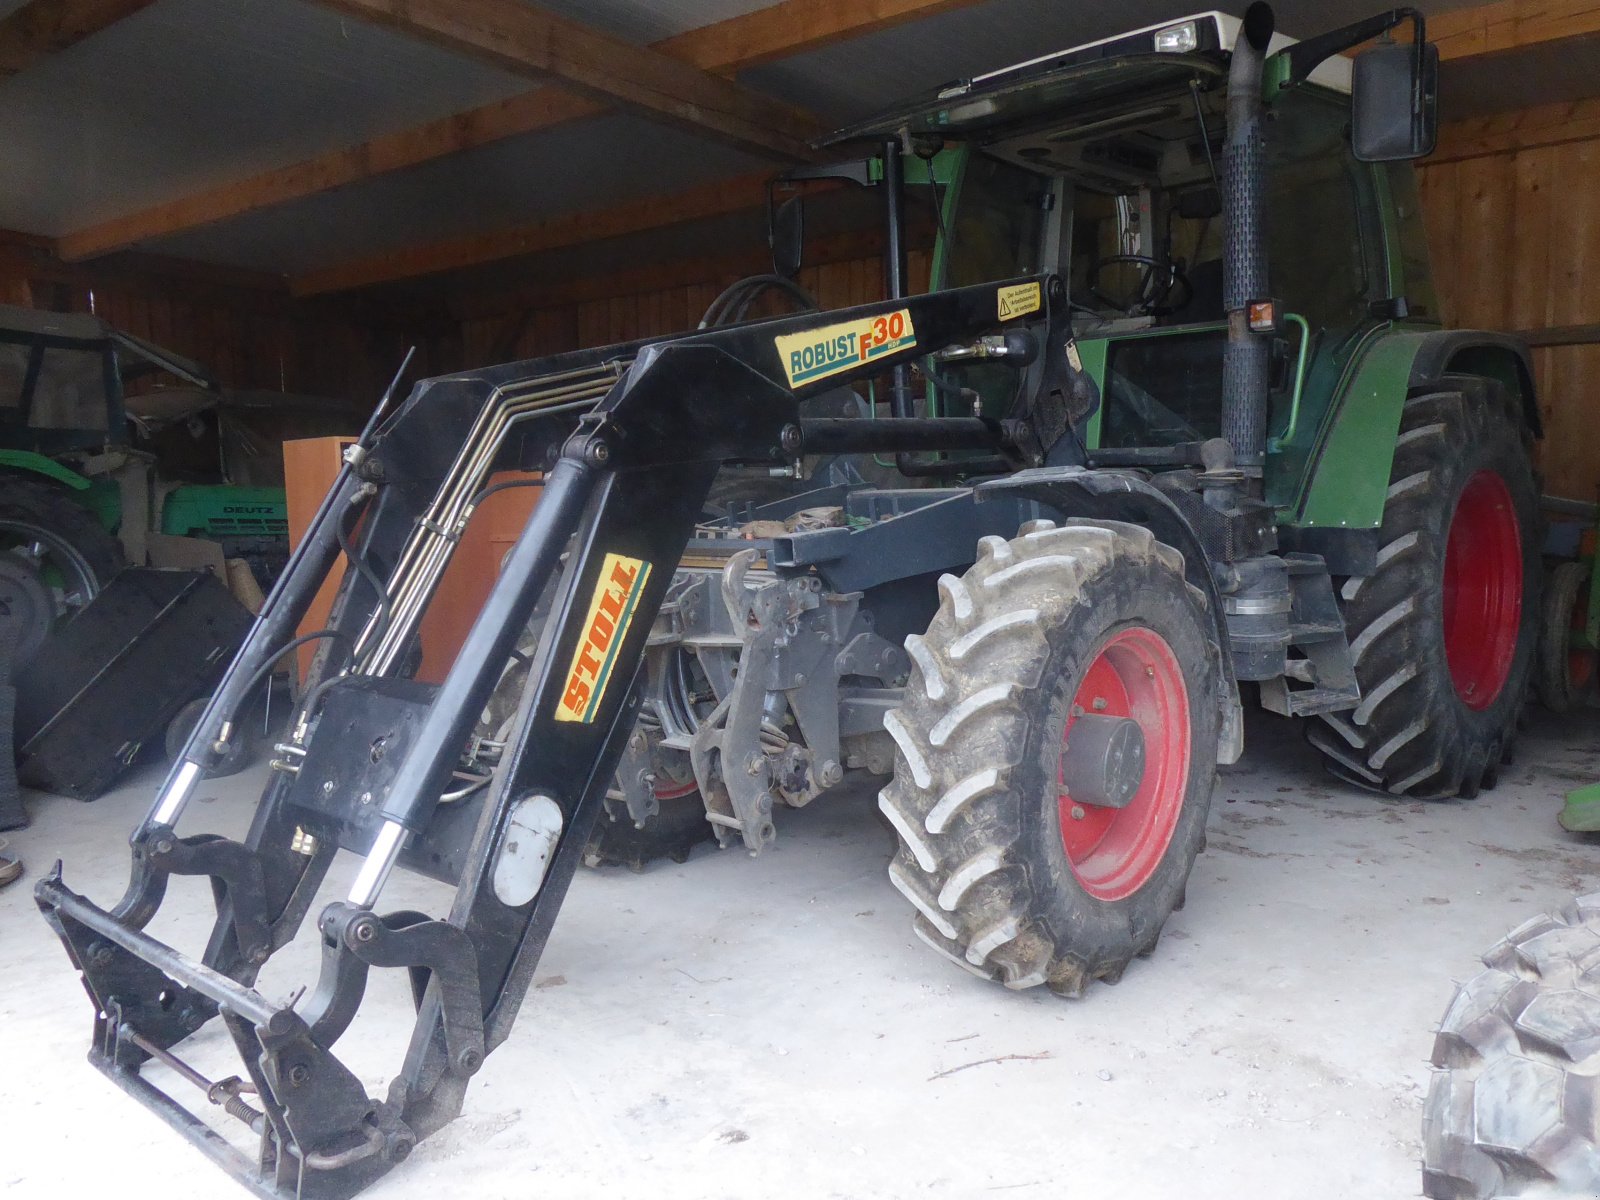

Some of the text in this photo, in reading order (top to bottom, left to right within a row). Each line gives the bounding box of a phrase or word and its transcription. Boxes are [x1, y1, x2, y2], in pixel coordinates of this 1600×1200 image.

[790, 332, 856, 374] ROBUST
[223, 506, 274, 514] DEUTZ
[563, 560, 637, 716] STOLL
